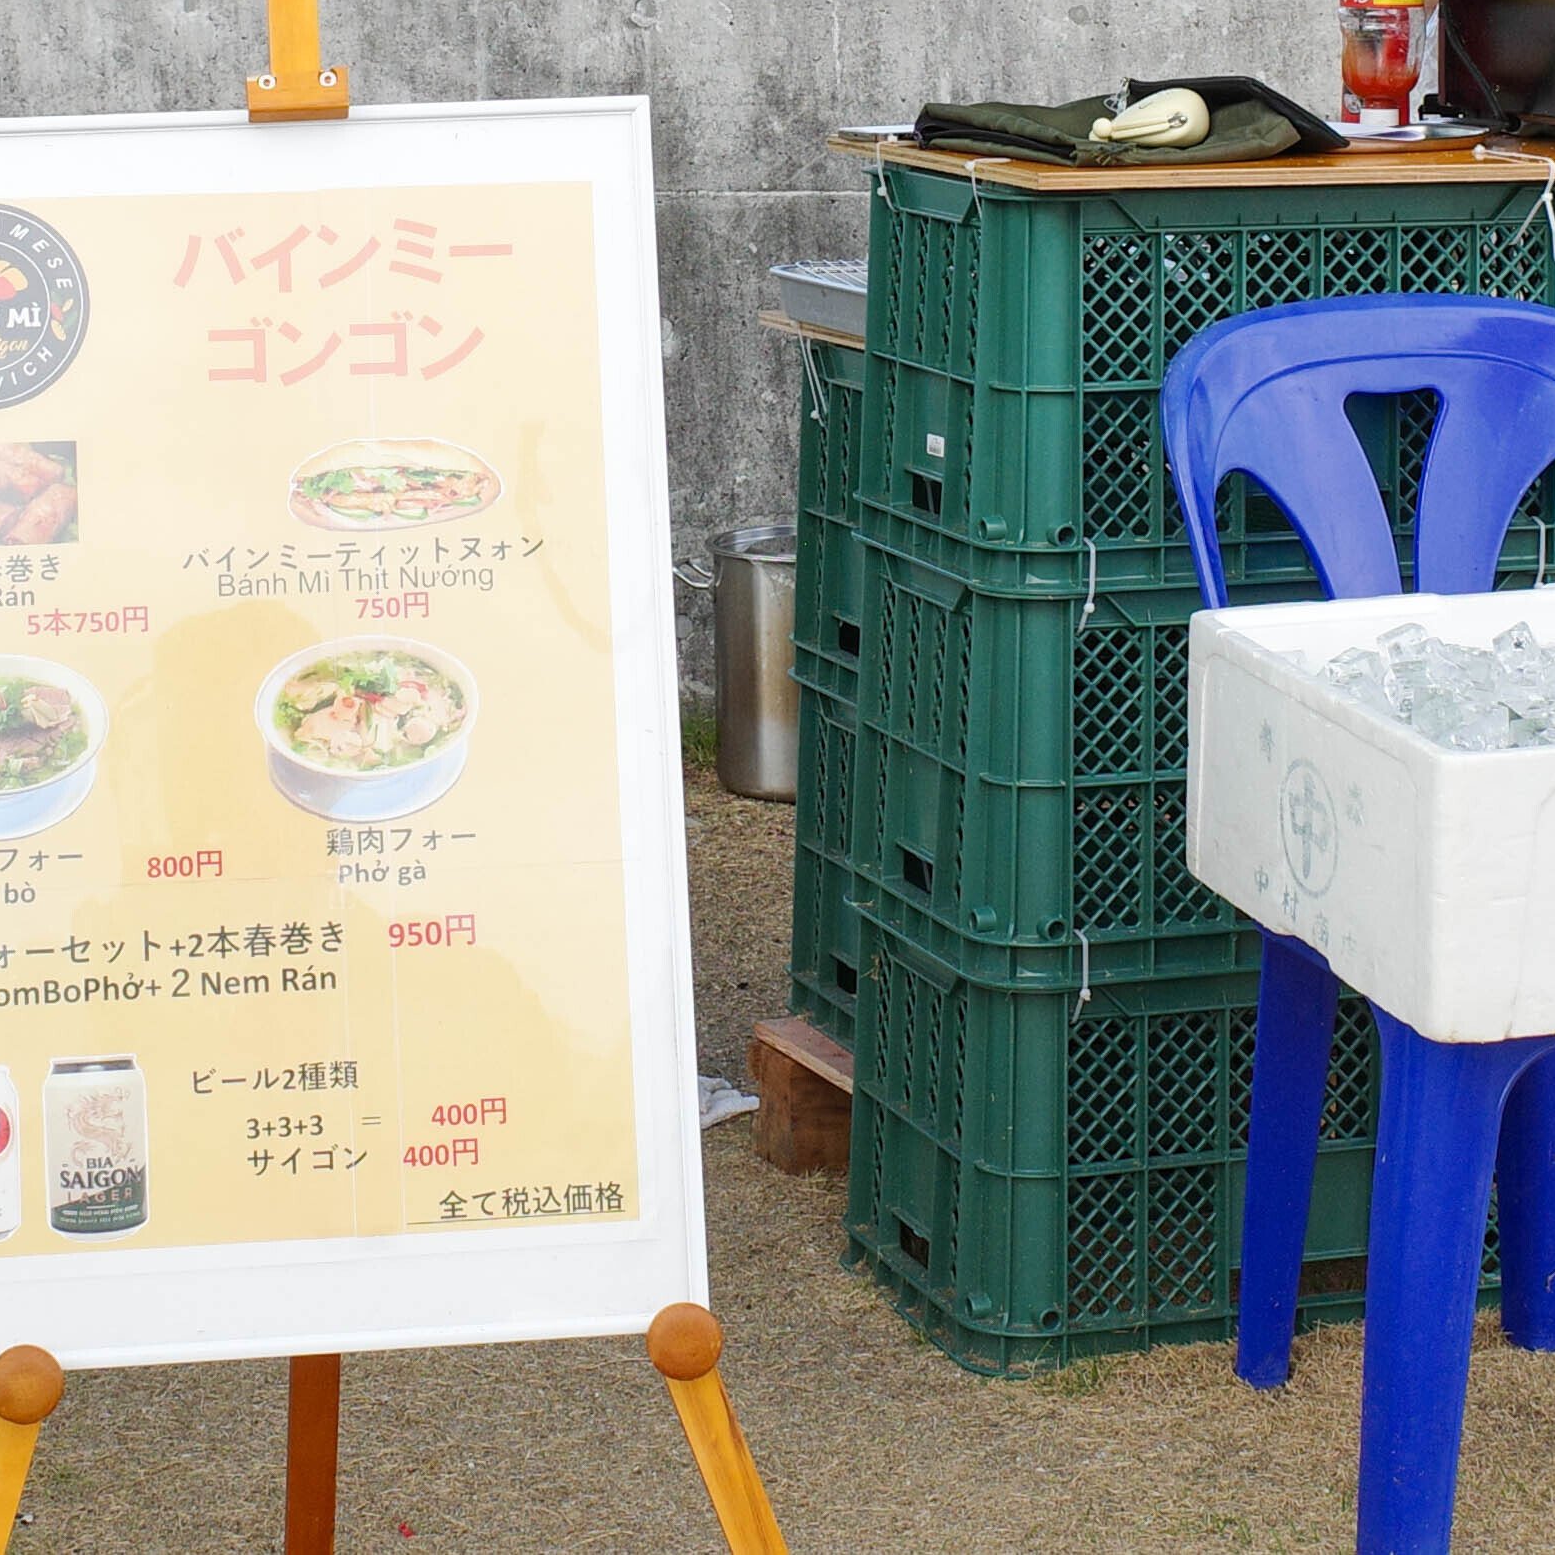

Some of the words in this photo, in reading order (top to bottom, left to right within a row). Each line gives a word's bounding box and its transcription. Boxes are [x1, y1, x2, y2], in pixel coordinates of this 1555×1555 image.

[173, 218, 513, 293] バインミー
[7, 302, 41, 328] MÌ
[208, 310, 486, 387] ゴンゴン
[183, 536, 544, 571] バインミーティットヌォン
[218, 571, 287, 597] Bánh
[298, 569, 330, 594] Mì
[343, 567, 389, 596] Thịt
[400, 565, 494, 592] Nướng
[27, 605, 149, 637] 5本750円
[354, 591, 430, 620] 750円
[325, 826, 477, 857] 鶏肉フォー
[147, 850, 223, 879] 800円
[338, 860, 389, 884] Phở
[398, 860, 427, 885] gà
[4, 882, 36, 905] bò
[388, 914, 477, 948] 950円
[171, 968, 191, 998] 2
[201, 970, 269, 996] Nem
[282, 965, 337, 992] Rán
[191, 1060, 359, 1095] ビール2種類
[246, 1114, 324, 1140] 3+3+3
[431, 1097, 508, 1127] 400円
[86, 1156, 113, 1169] BIA
[247, 1144, 368, 1176] サイゴン
[402, 1138, 479, 1168] 400円
[60, 1166, 145, 1189] SAIGON
[66, 1187, 133, 1204] LAGER
[439, 1181, 624, 1219] 全て税込価格
